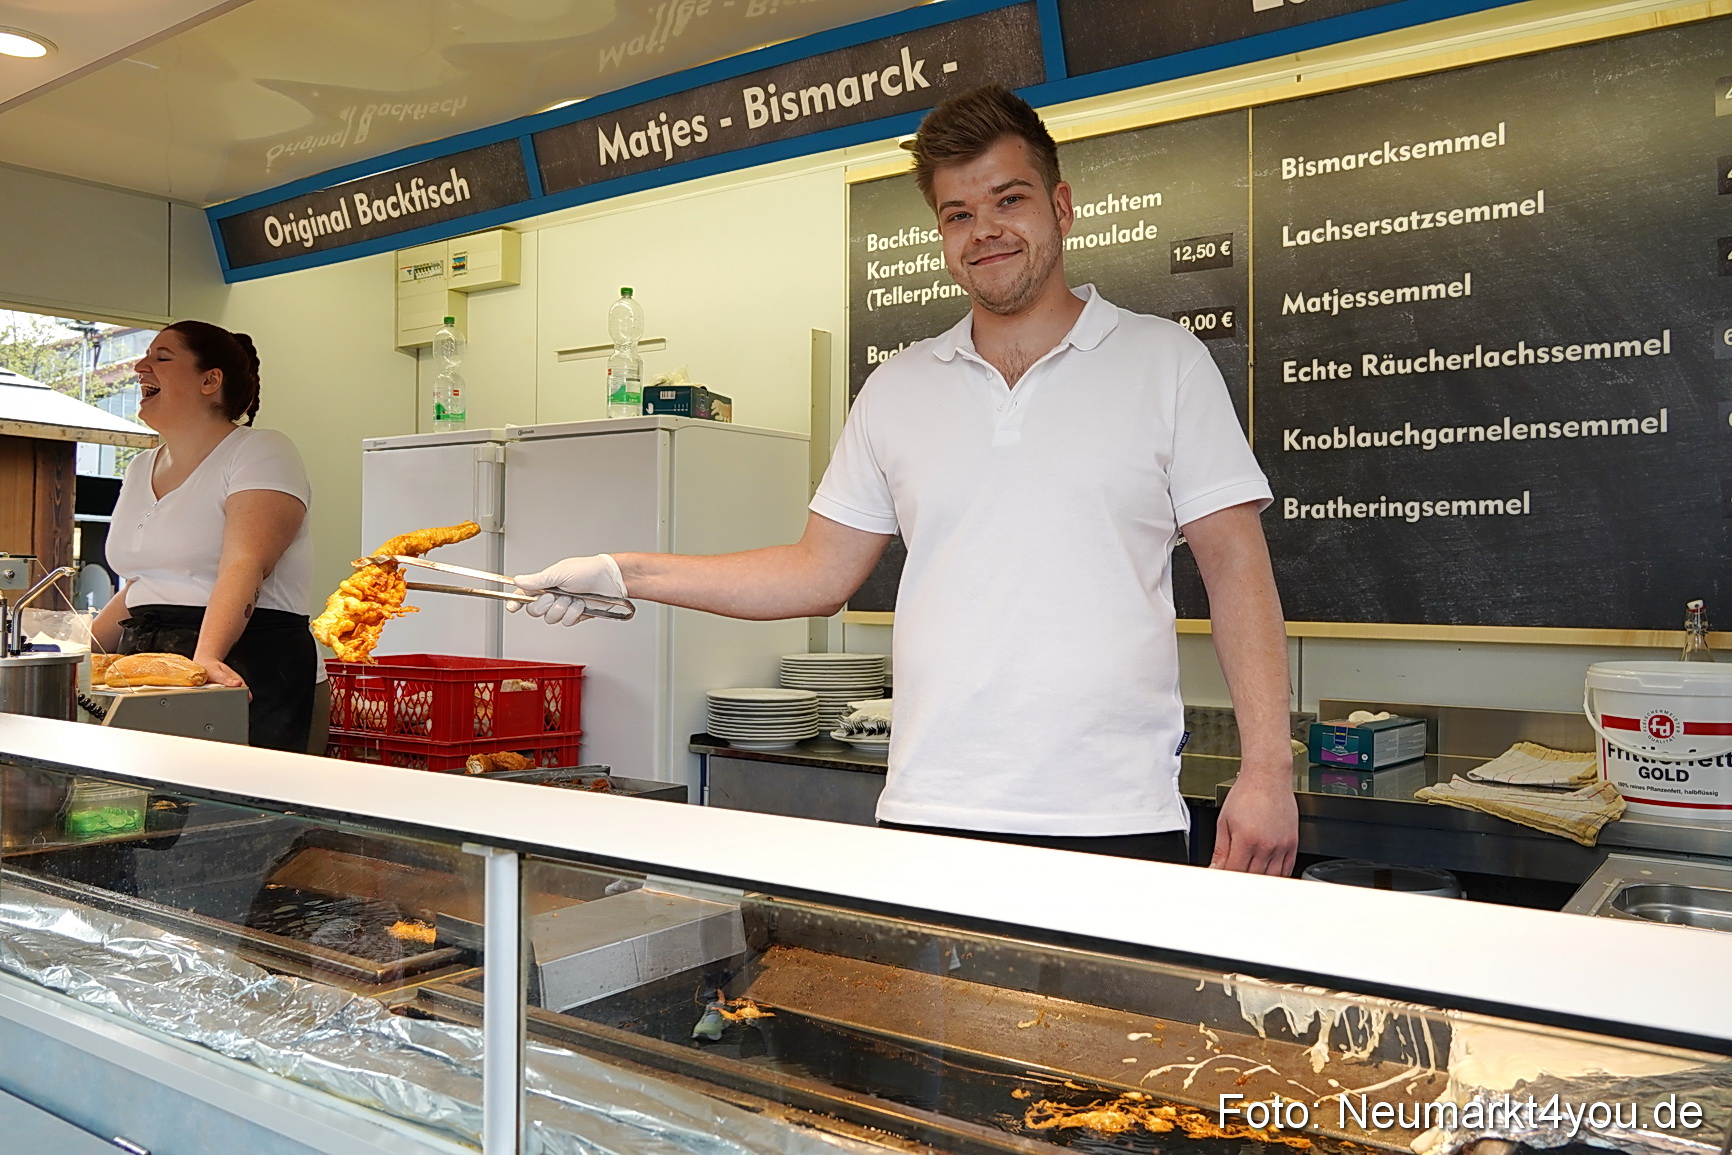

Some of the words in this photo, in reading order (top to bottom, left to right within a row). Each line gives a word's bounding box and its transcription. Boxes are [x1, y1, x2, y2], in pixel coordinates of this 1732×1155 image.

[598, 112, 709, 166] Matjes
[720, 117, 732, 128] -
[743, 46, 931, 130] Bismarck
[942, 61, 958, 74] -
[1281, 122, 1505, 180] Bismarcksemmel
[264, 197, 352, 248] Original
[354, 167, 471, 226] Backfisch
[1282, 189, 1544, 248] Lachsersatzsemmel
[867, 226, 943, 252] Backfisc
[867, 251, 948, 280] Kartoffel
[1063, 220, 1158, 251] moulade
[1173, 242, 1216, 262] 12,50
[1220, 241, 1231, 256] €
[867, 280, 969, 311] (Tellerpfan
[1281, 272, 1471, 317] Matjessemmel
[1180, 313, 1216, 334] 9,00
[1221, 311, 1233, 328] €
[1283, 360, 1352, 383] Echte
[1362, 329, 1671, 377] Räucherlachssemmel
[1283, 408, 1668, 451] Knoblauchgarnelensemmel
[1283, 490, 1530, 523] Bratheringsemmel
[1638, 766, 1690, 782] GOLD
[1684, 789, 1719, 797] halbflüssig
